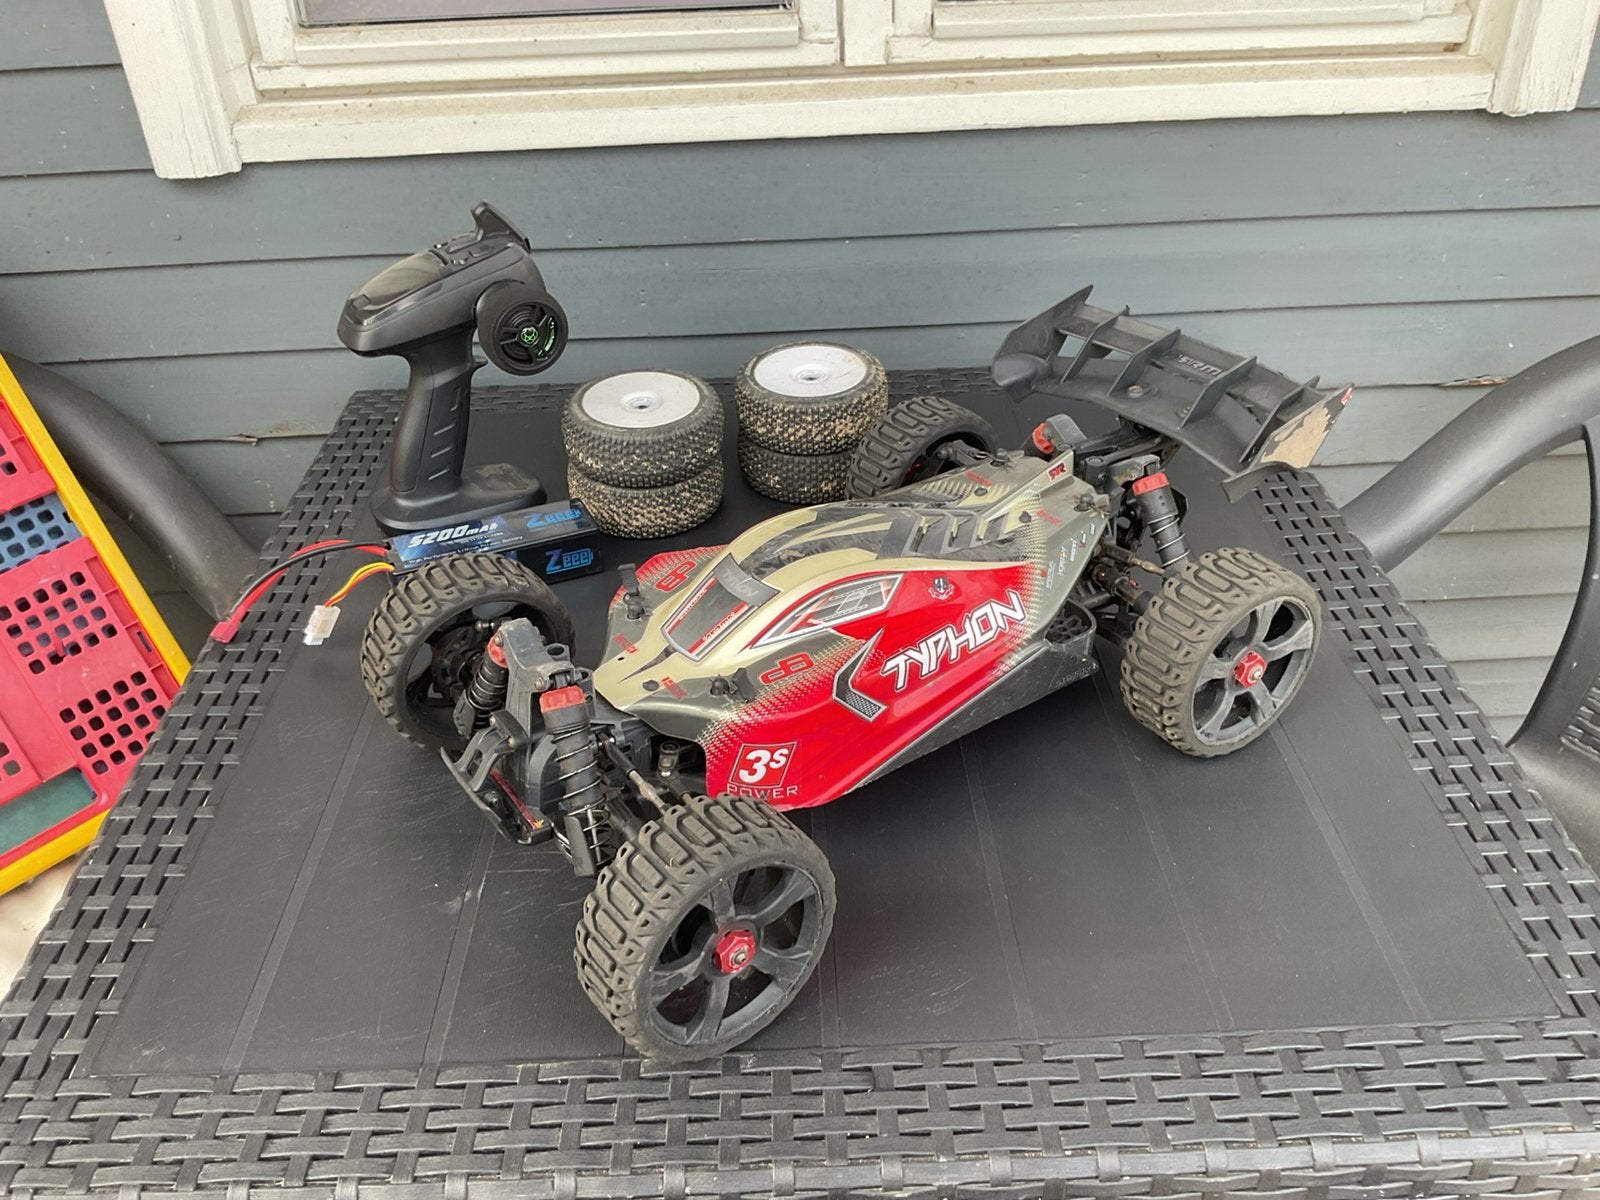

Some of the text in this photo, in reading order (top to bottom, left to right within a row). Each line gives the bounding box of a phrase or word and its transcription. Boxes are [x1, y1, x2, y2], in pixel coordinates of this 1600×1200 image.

[544, 548, 594, 575] Zeee
[880, 588, 1028, 692] TYPHON
[726, 784, 799, 801] POWER
